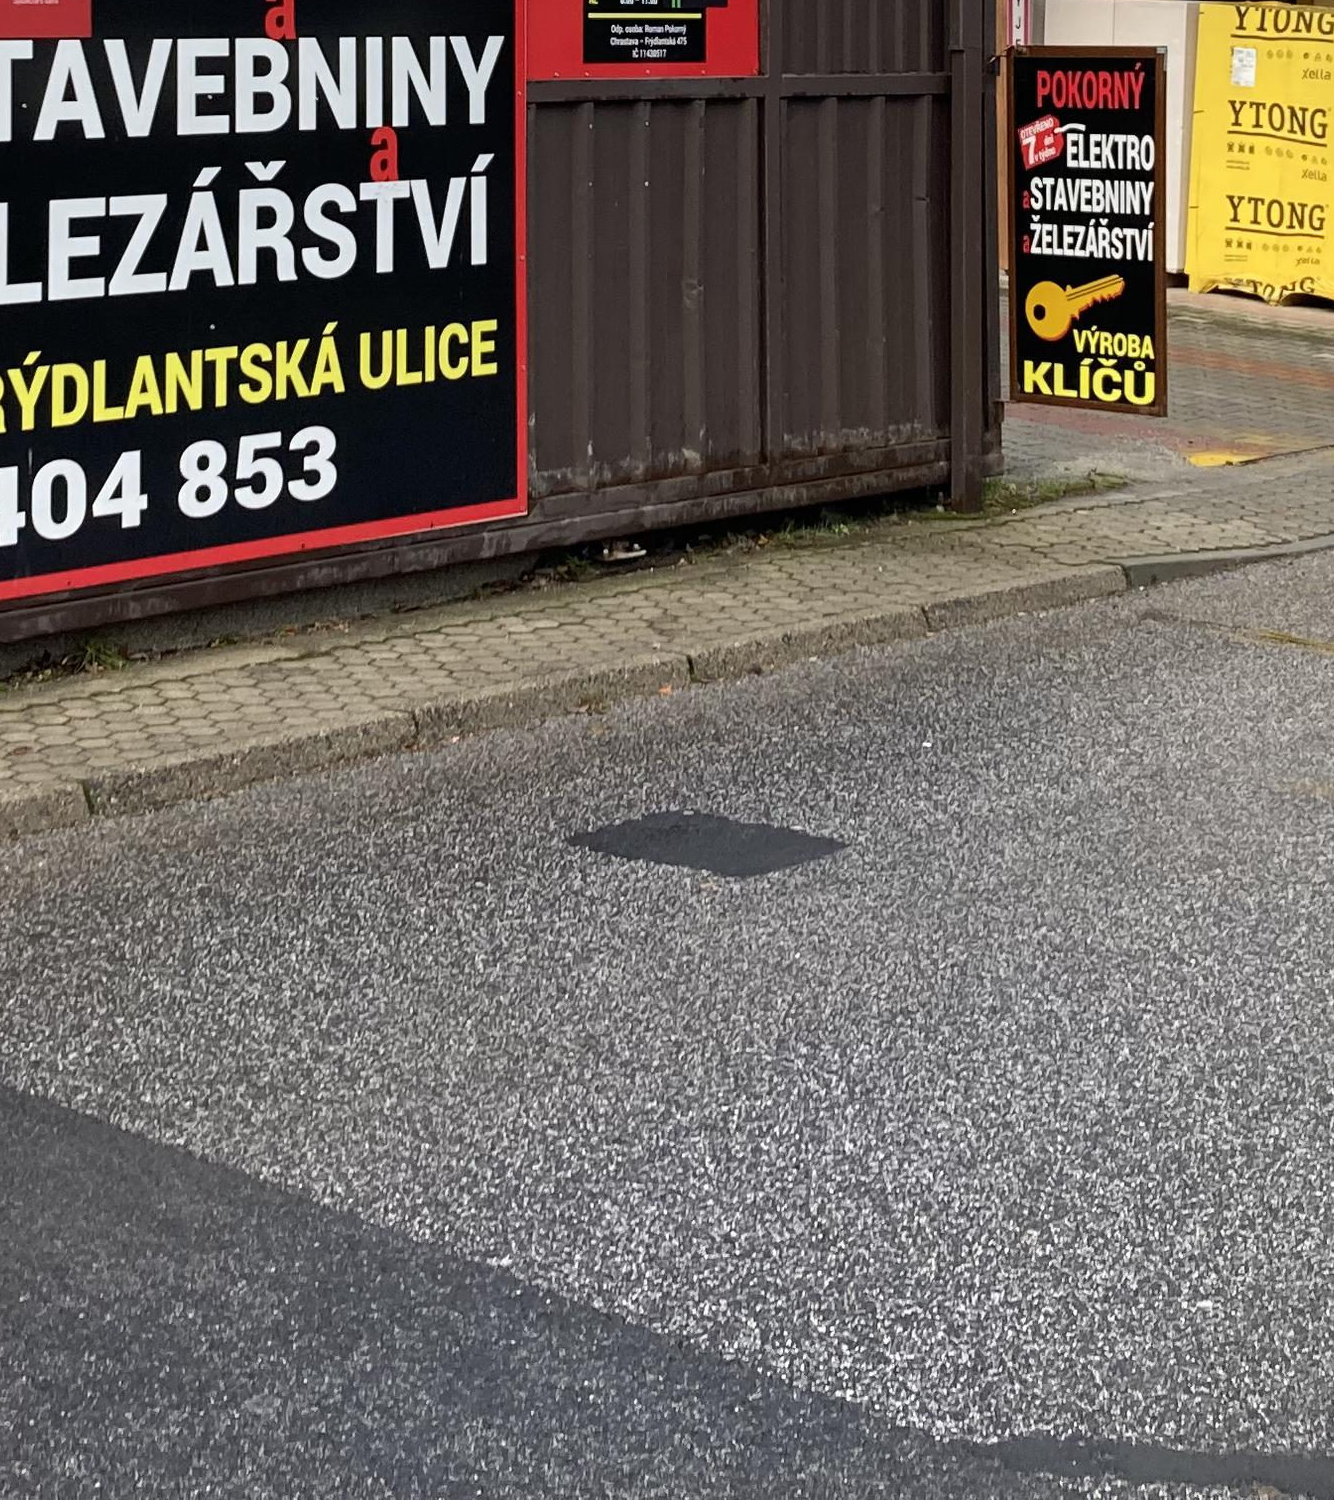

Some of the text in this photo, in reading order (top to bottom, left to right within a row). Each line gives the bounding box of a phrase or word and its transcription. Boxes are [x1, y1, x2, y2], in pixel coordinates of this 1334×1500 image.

[1036, 62, 1145, 110] POKORNÝ
[1228, 100, 1328, 139] YTONG
[370, 126, 399, 181] a
[1022, 135, 1036, 165] 7
[1066, 133, 1155, 171] ELEKTRO
[1030, 177, 1154, 216] STAVEBNINY
[1226, 195, 1325, 231] YTONG
[1030, 215, 1155, 261] ŽELEZÁŘSTVÍ
[359, 319, 498, 389] ULICE
[1073, 325, 1155, 359] VÝROBA
[1023, 358, 1155, 406] KLÍČŮ
[177, 425, 338, 519] 853
